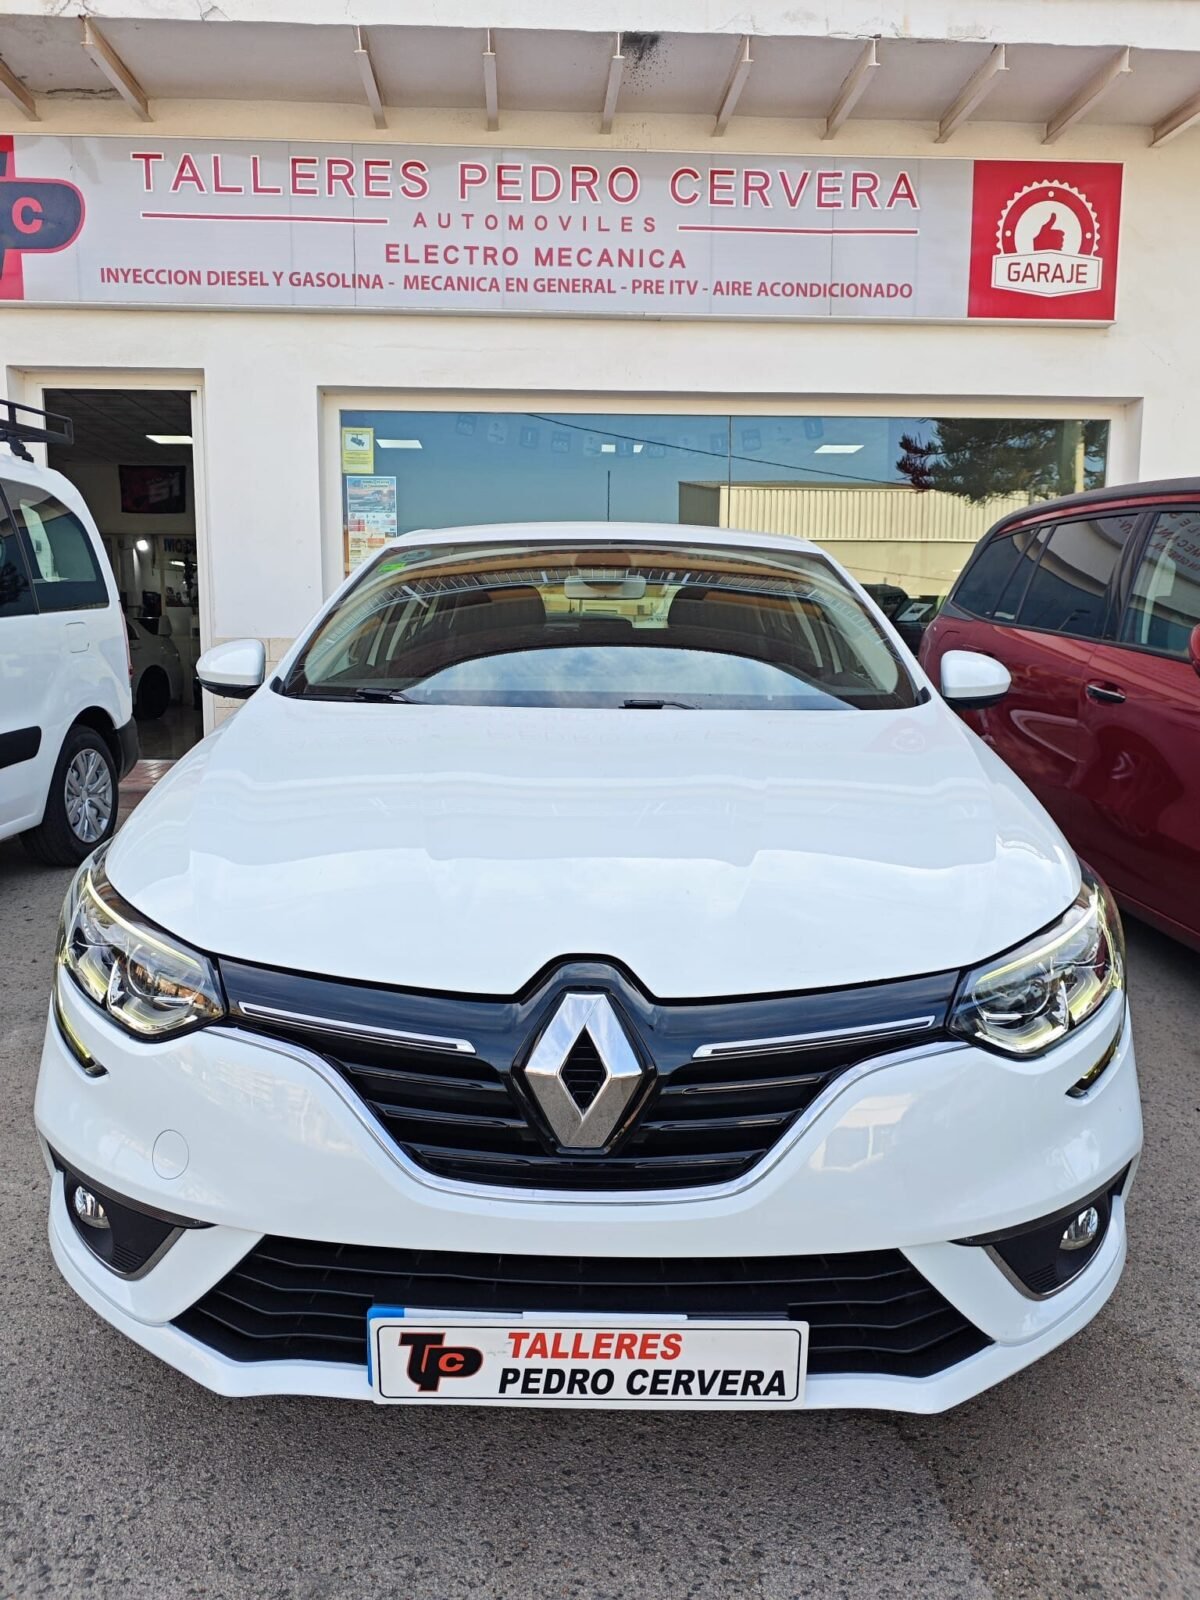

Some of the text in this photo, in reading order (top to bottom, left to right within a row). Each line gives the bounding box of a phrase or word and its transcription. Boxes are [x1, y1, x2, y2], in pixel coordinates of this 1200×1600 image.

[132, 152, 919, 210] TALLERES PEDRO CERVERA
[413, 211, 656, 233] AUTOMOVILES
[384, 242, 686, 269] ELECTRO MECANICA
[100, 267, 203, 287] INYECCION
[206, 269, 270, 287] DIESEL
[273, 271, 286, 287] Y
[288, 271, 384, 290] GASOLINA
[403, 274, 500, 292] MECANICA
[505, 276, 530, 292] EN
[533, 277, 616, 294] GENERAL
[631, 279, 665, 295] PRE
[668, 279, 698, 295] ITV
[712, 280, 753, 297] AIRE
[757, 281, 913, 299] ACONDICIONADO
[1007, 261, 1089, 285] GARAJE
[507, 1331, 683, 1361] TALLERES
[498, 1367, 787, 1397] PEDRO CERVERA
